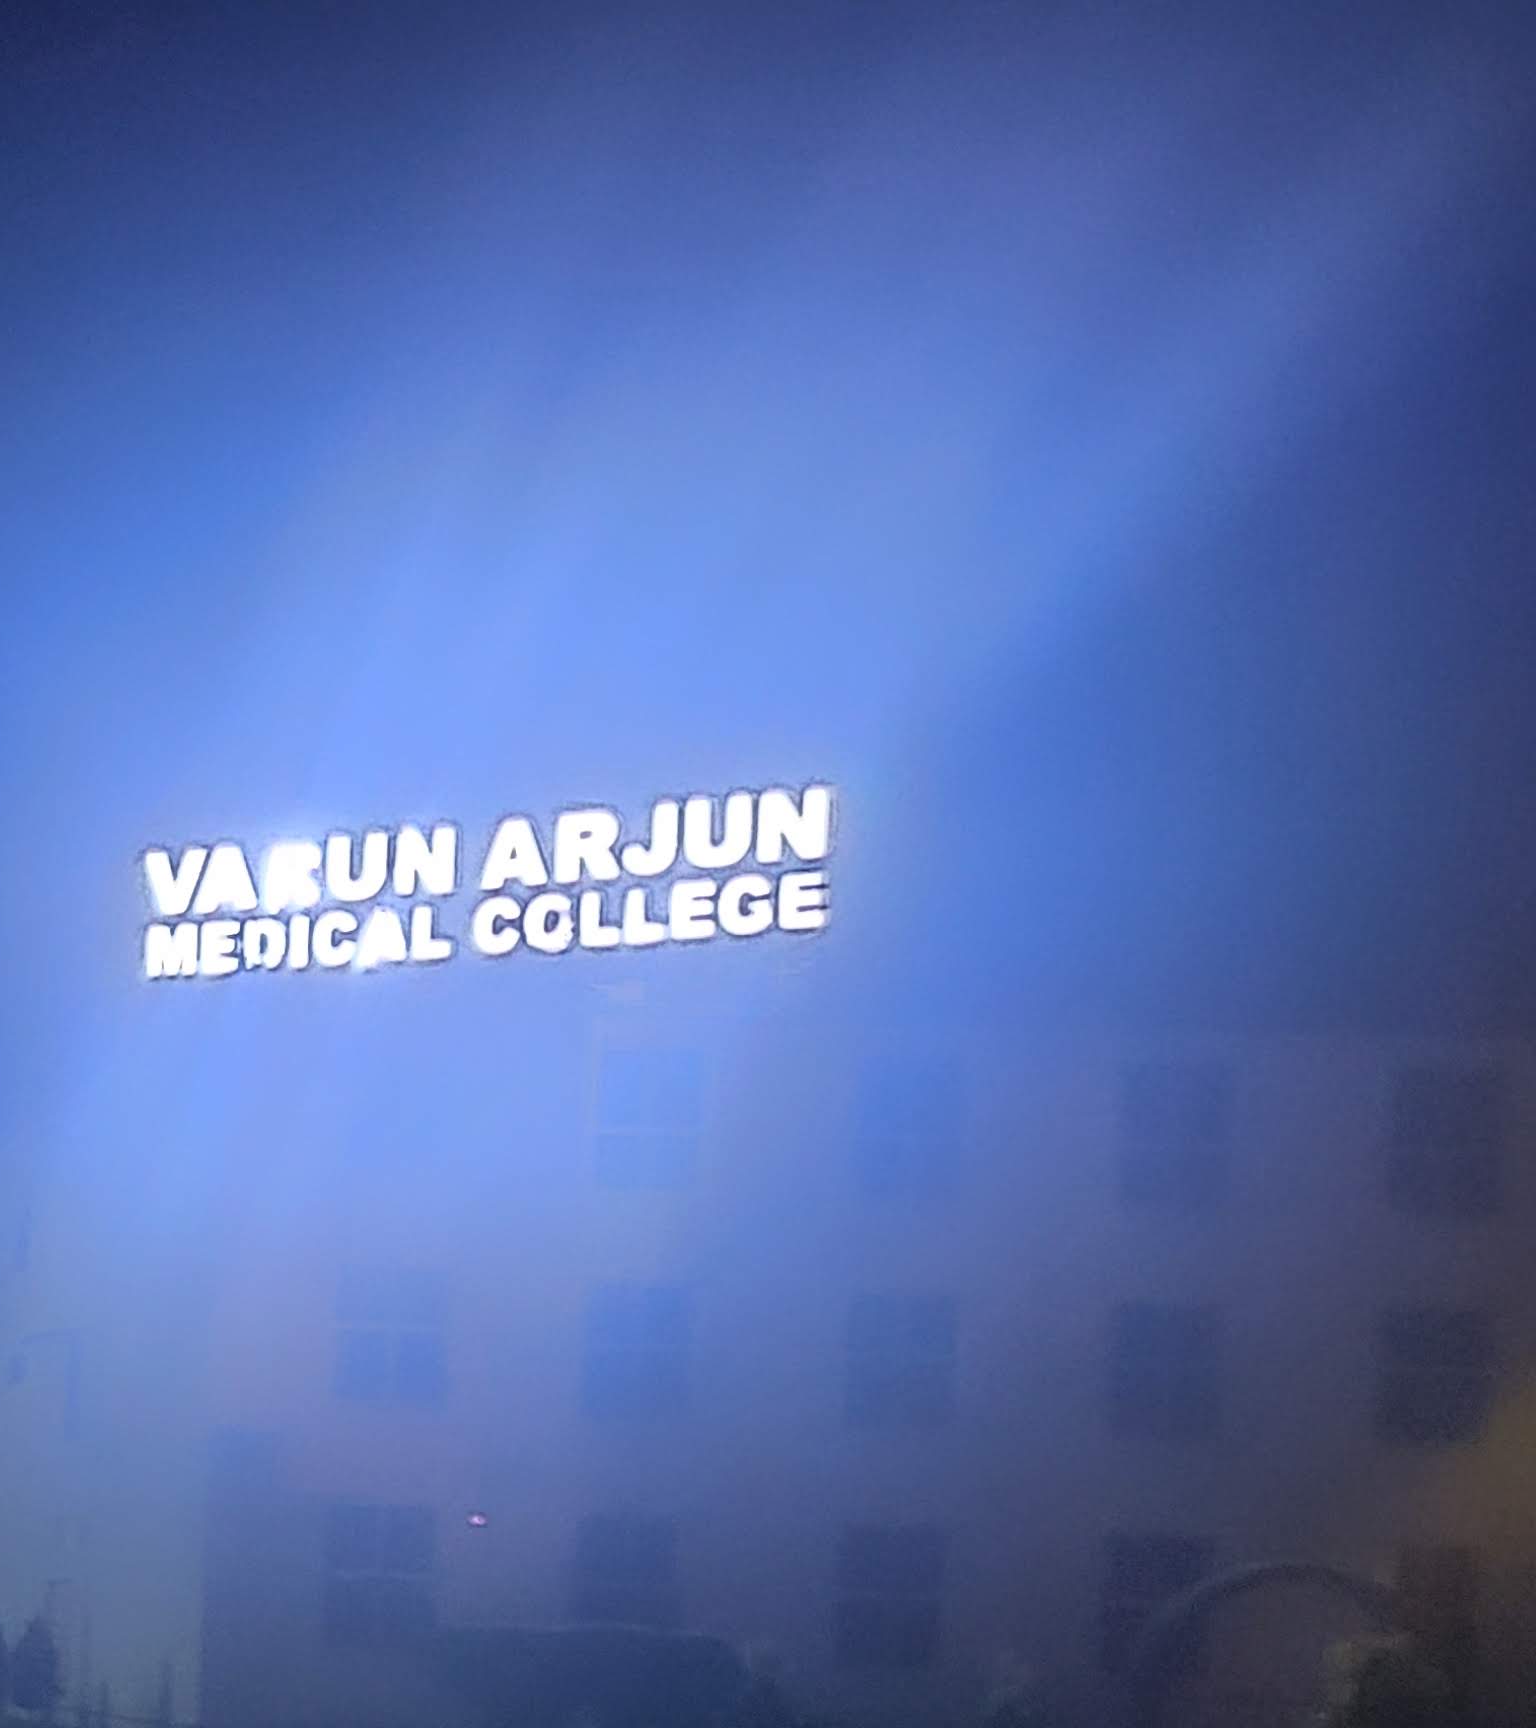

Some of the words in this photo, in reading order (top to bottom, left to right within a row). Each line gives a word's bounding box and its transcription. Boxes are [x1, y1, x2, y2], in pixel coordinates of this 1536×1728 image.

[145, 825, 456, 915] VARUN
[480, 787, 829, 890] ARJUN
[145, 906, 451, 978] MEDICAL
[472, 872, 827, 953] COLLEGE
